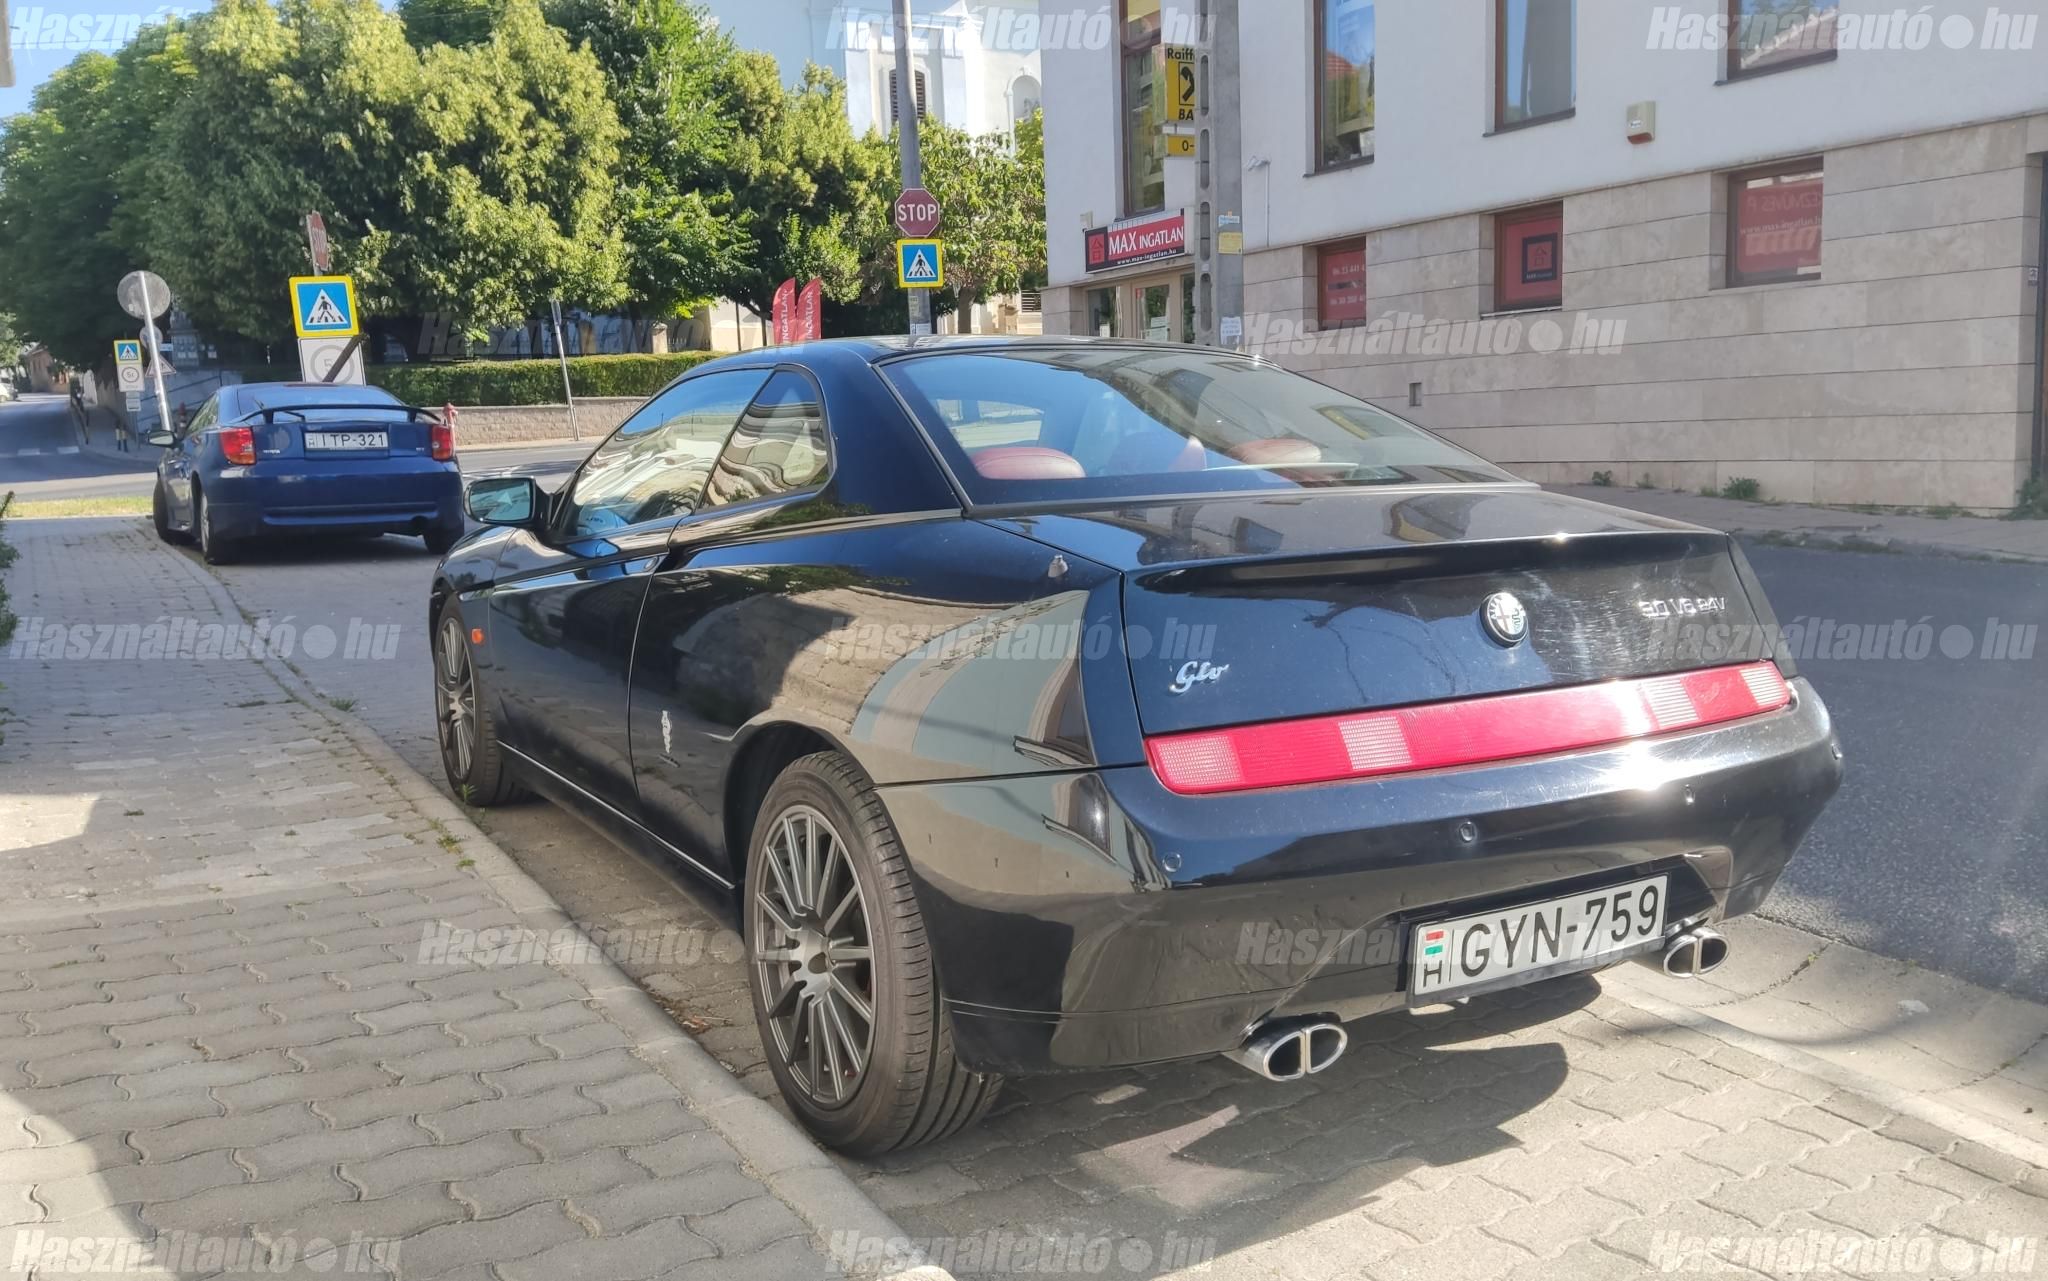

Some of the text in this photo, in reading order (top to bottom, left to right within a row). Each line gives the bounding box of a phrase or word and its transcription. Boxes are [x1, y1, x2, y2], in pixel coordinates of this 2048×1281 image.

[1167, 48, 1195, 60] Raiff
[1178, 108, 1194, 120] BA
[1182, 140, 1195, 151] 0-
[898, 204, 937, 221] STOP
[1108, 226, 1184, 255] MAX INGATLAN
[1117, 248, 1177, 265] www.max-ingatlan.hu
[323, 433, 385, 447] ITP-321
[1460, 885, 1659, 977] GYN-759
[1423, 960, 1443, 987] H
